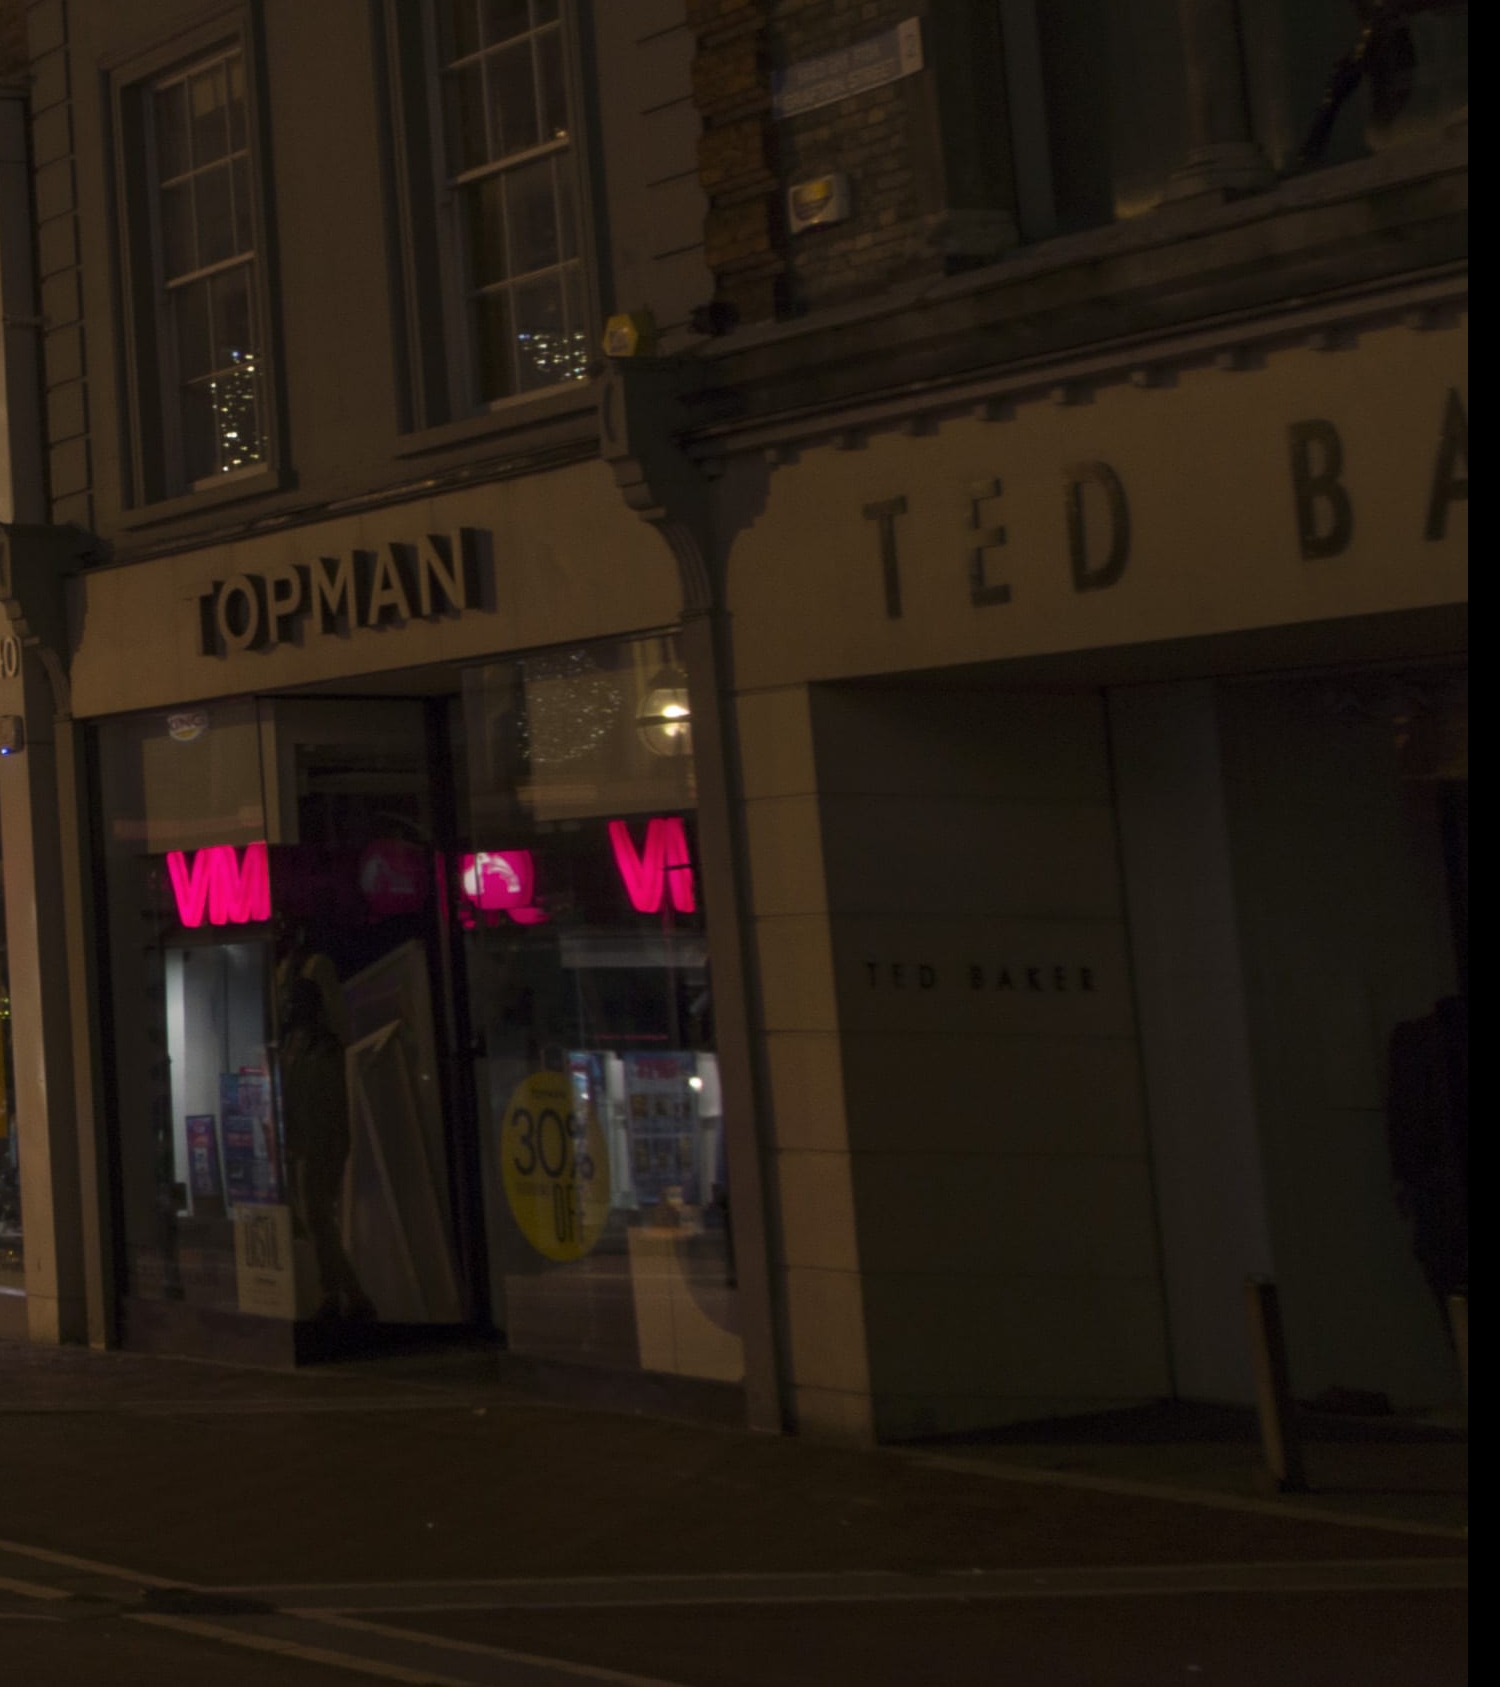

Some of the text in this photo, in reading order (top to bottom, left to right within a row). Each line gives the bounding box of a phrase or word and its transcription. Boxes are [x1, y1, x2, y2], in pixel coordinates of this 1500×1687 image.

[184, 526, 481, 656] TOPMAN
[862, 460, 1132, 620] TED
[864, 961, 1097, 992] TED BAKER
[511, 1106, 595, 1180] 30%
